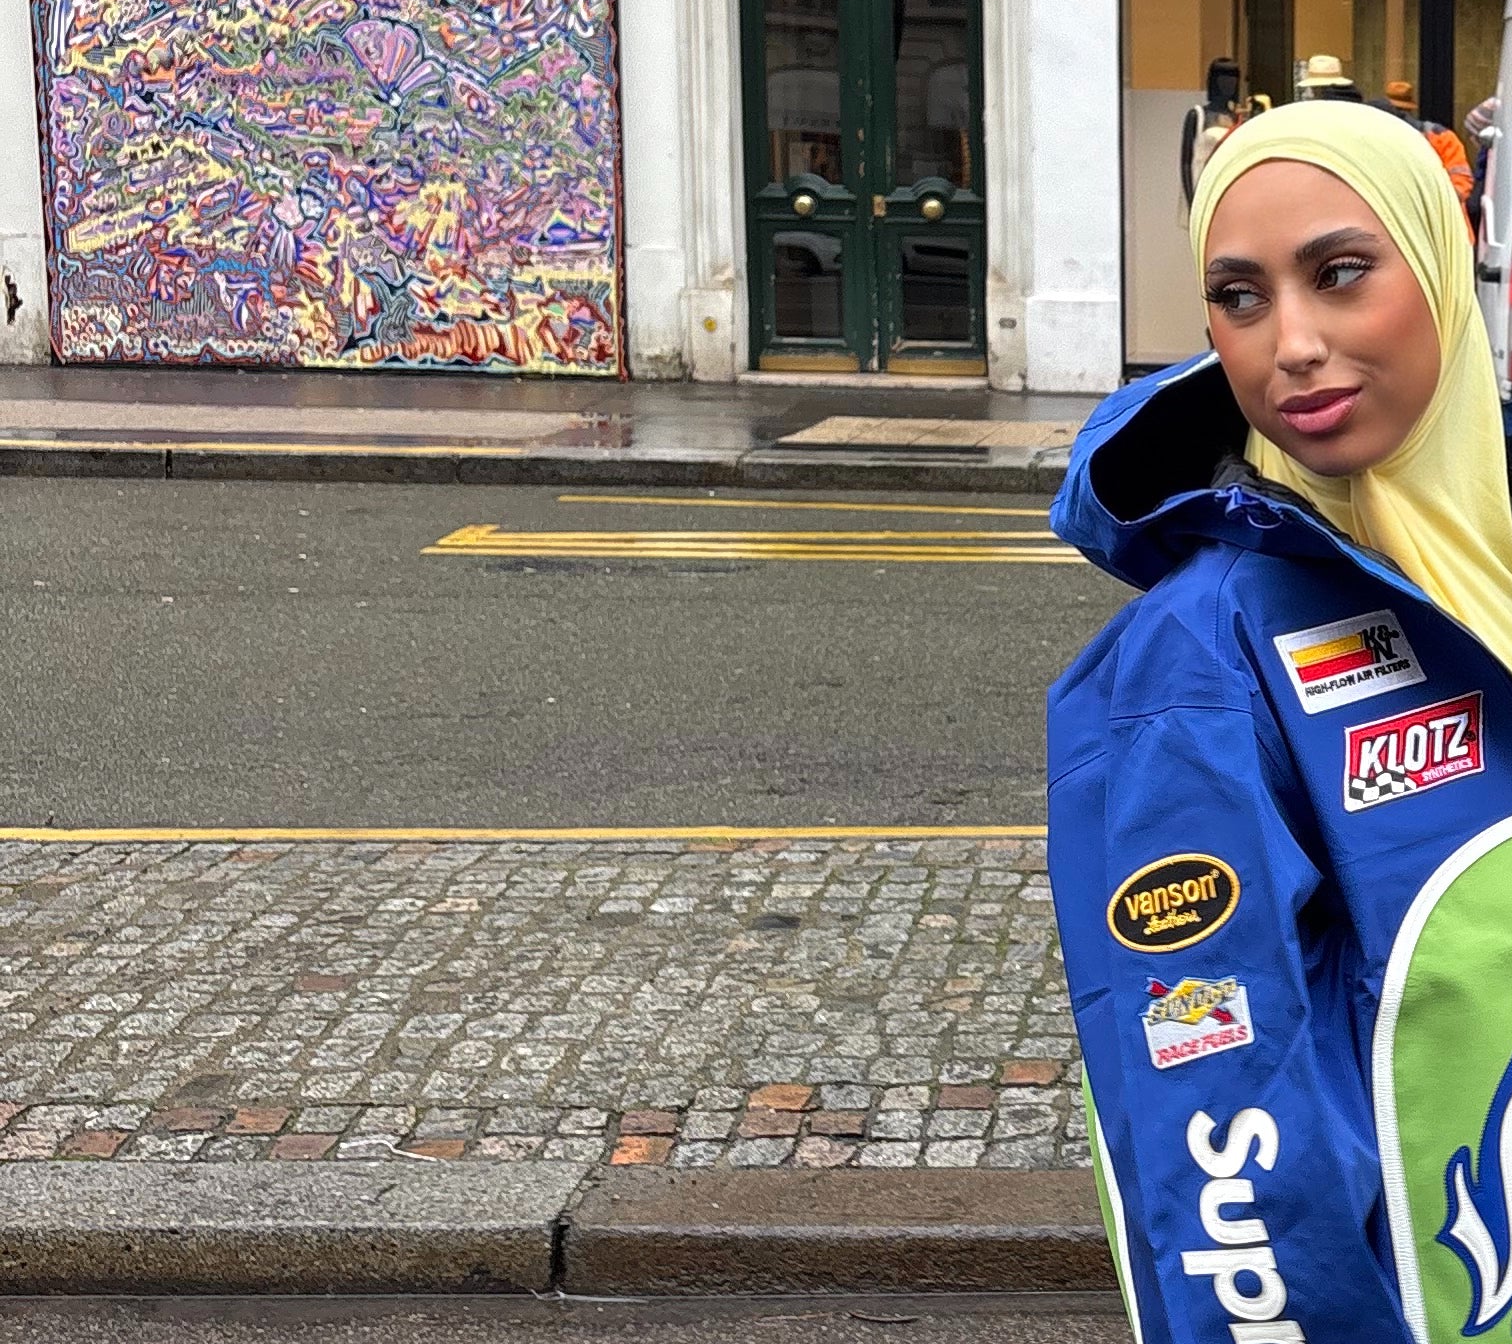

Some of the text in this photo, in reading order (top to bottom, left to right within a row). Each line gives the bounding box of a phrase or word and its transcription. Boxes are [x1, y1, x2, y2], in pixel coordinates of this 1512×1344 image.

[1357, 669, 1374, 683] AIR
[1375, 658, 1411, 678] FILTERS
[1359, 711, 1469, 779] KLOTZ
[1124, 874, 1218, 921] vanson
